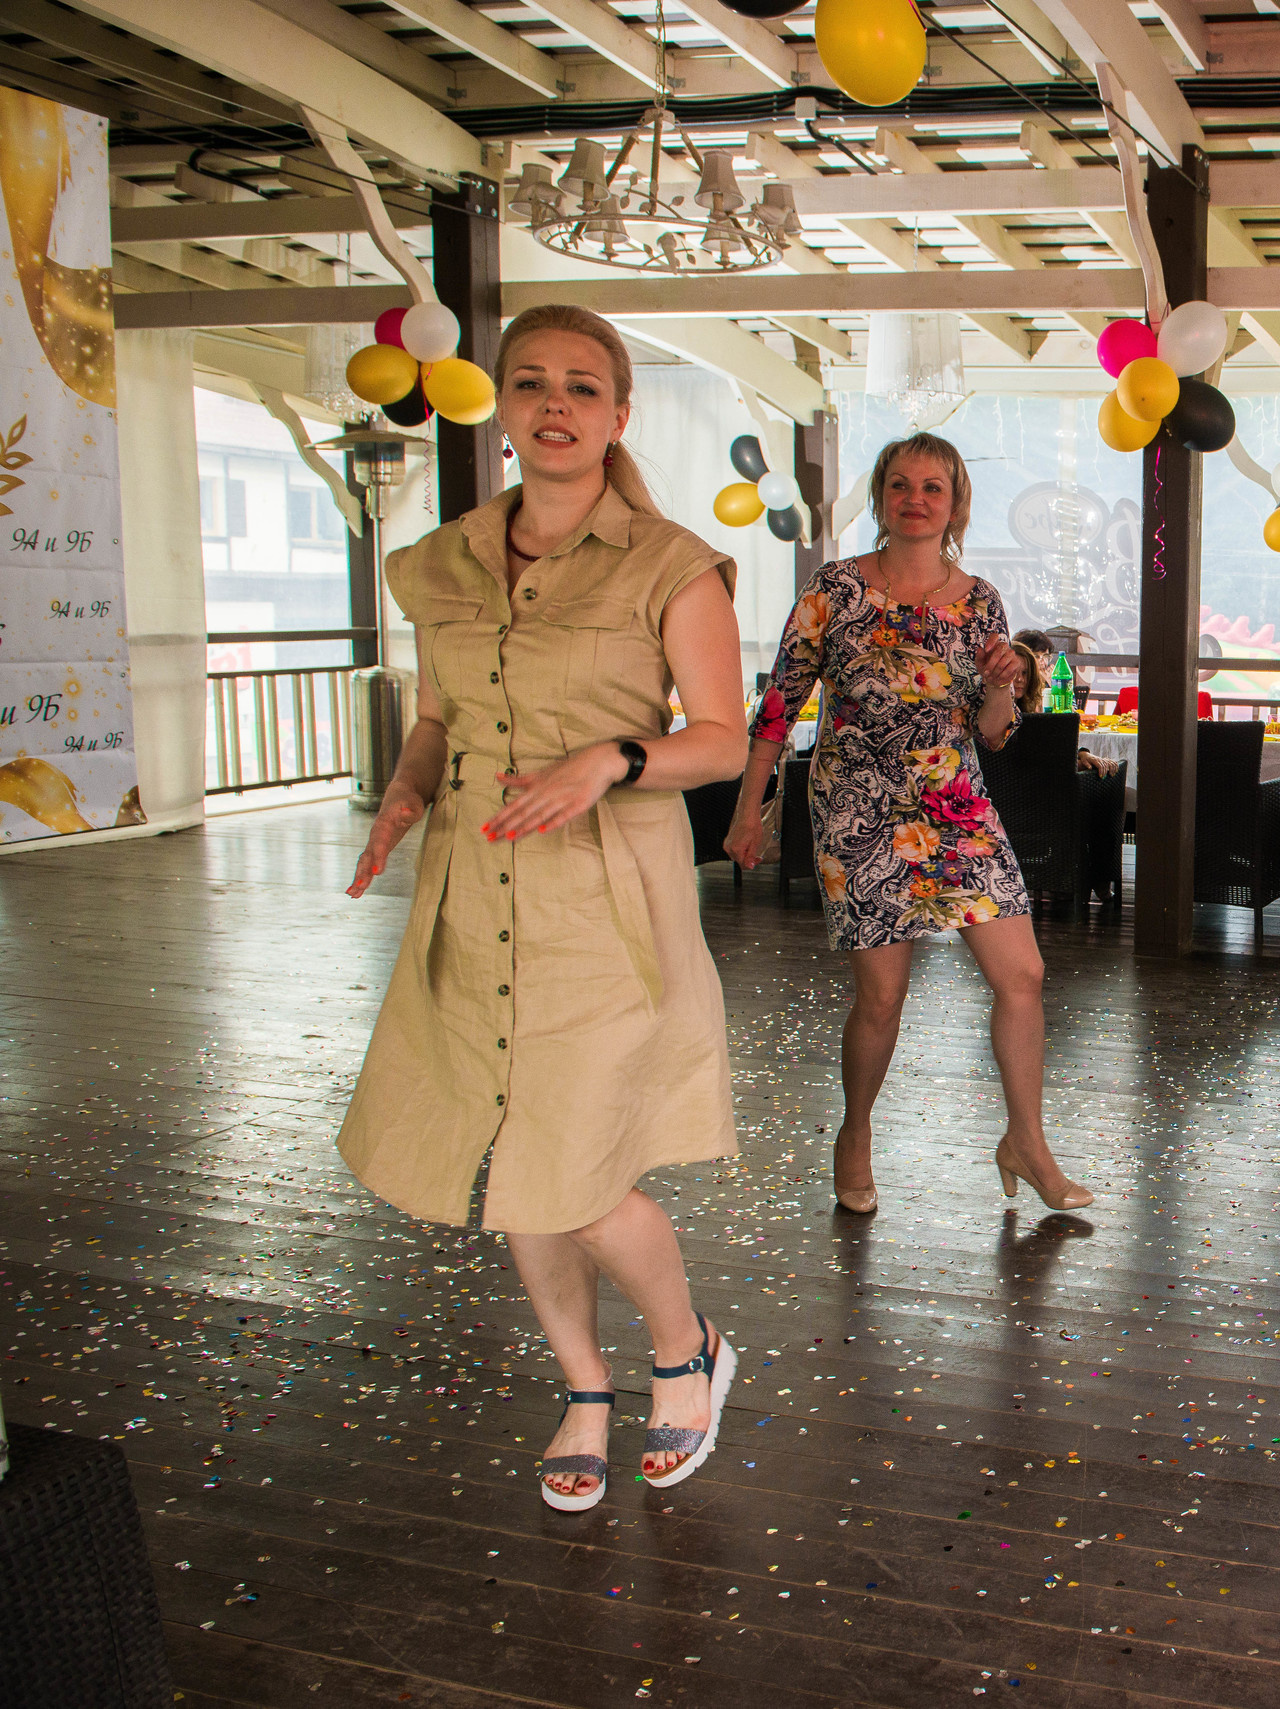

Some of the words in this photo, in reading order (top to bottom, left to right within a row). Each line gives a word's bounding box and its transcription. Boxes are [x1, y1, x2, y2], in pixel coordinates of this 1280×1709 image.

[9, 528, 39, 551] 9А
[45, 537, 59, 552] и
[64, 530, 94, 552] 9Б
[49, 601, 71, 619] 9А
[75, 607, 85, 618] и
[89, 601, 111, 618] 9Б
[0, 706, 18, 725] и
[25, 694, 63, 723] 9Б
[61, 736, 84, 753] 9А
[87, 740, 98, 751] и
[103, 732, 124, 750] 9Б
